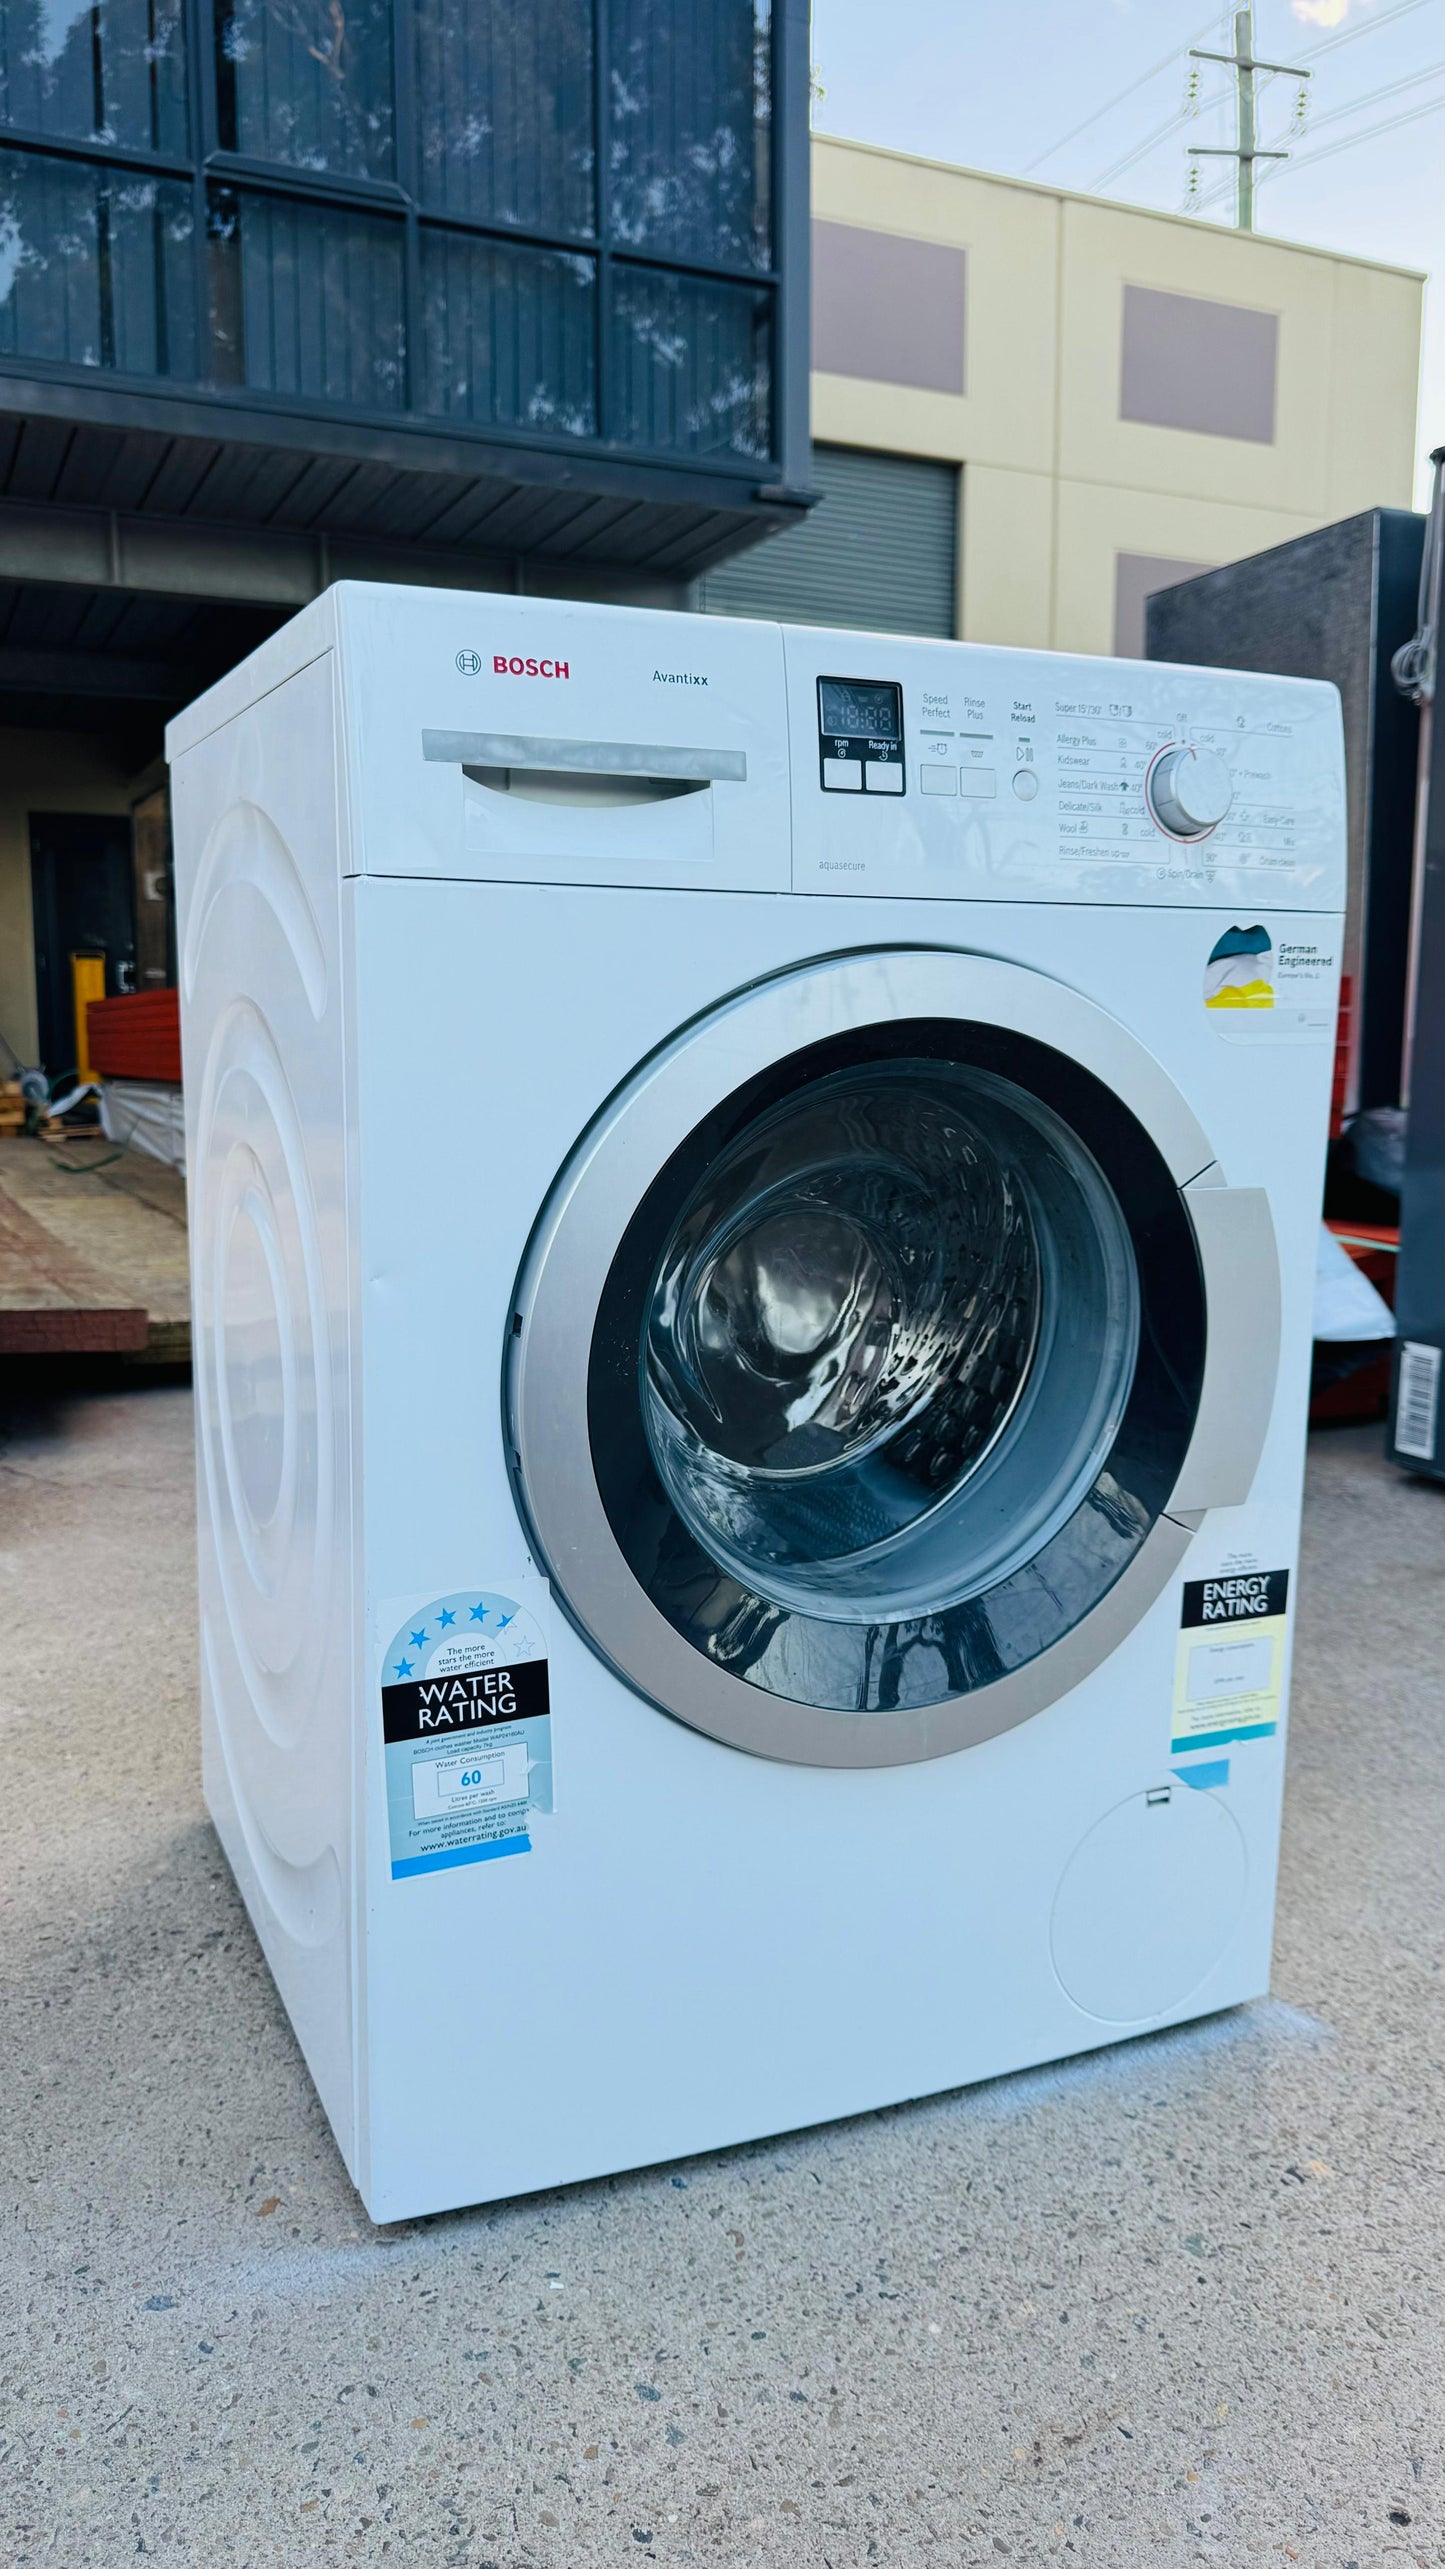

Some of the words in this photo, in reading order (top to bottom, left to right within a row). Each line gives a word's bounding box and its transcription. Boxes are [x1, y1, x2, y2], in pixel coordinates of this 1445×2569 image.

[493, 656, 570, 679] BOSCH
[653, 670, 708, 686] Avantixx
[923, 693, 948, 706] Speed
[964, 697, 985, 708] Rinse
[1013, 701, 1032, 711] Start
[922, 706, 950, 719] Perfect
[967, 709, 984, 720] Plus
[1055, 702, 1077, 714] Super
[1011, 714, 1036, 724] Reload
[834, 739, 849, 749] rpm
[869, 740, 889, 751] Ready
[890, 742, 897, 750] in
[1056, 734, 1080, 747] Allergy
[1081, 735, 1096, 747] Plus
[1057, 755, 1090, 767] Kidswear
[1059, 823, 1077, 834] Wool
[1139, 827, 1155, 838] cold
[819, 860, 866, 872] aquasecure
[1280, 943, 1318, 954] German
[1278, 955, 1333, 968] Engineered
[1203, 1576, 1270, 1601] ENERGY
[1202, 1595, 1269, 1620] RATING
[447, 1647, 462, 1656] The
[465, 1644, 485, 1653] more
[438, 1656, 457, 1665] stars
[459, 1653, 472, 1661] the
[474, 1650, 495, 1659] more
[440, 1664, 462, 1673] water
[464, 1658, 494, 1669] efficient
[418, 1671, 514, 1705] WATER
[418, 1693, 517, 1729] RATING
[413, 1747, 434, 1755] BOSCH
[461, 1744, 482, 1753] capacity
[435, 1759, 457, 1768] Water
[460, 1751, 505, 1765] Consumption
[461, 1770, 482, 1786] 60
[451, 1795, 468, 1803] Litres
[469, 1793, 479, 1801] per
[480, 1789, 495, 1797] wash
[409, 1829, 420, 1838] For
[422, 1826, 441, 1834] more
[443, 1817, 482, 1831] information
[484, 1813, 497, 1822] and
[440, 1827, 477, 1840] appliances,
[478, 1822, 494, 1831] refer
[496, 1819, 506, 1828] to:
[420, 1825, 527, 1852] www.waterrating.gov.au
